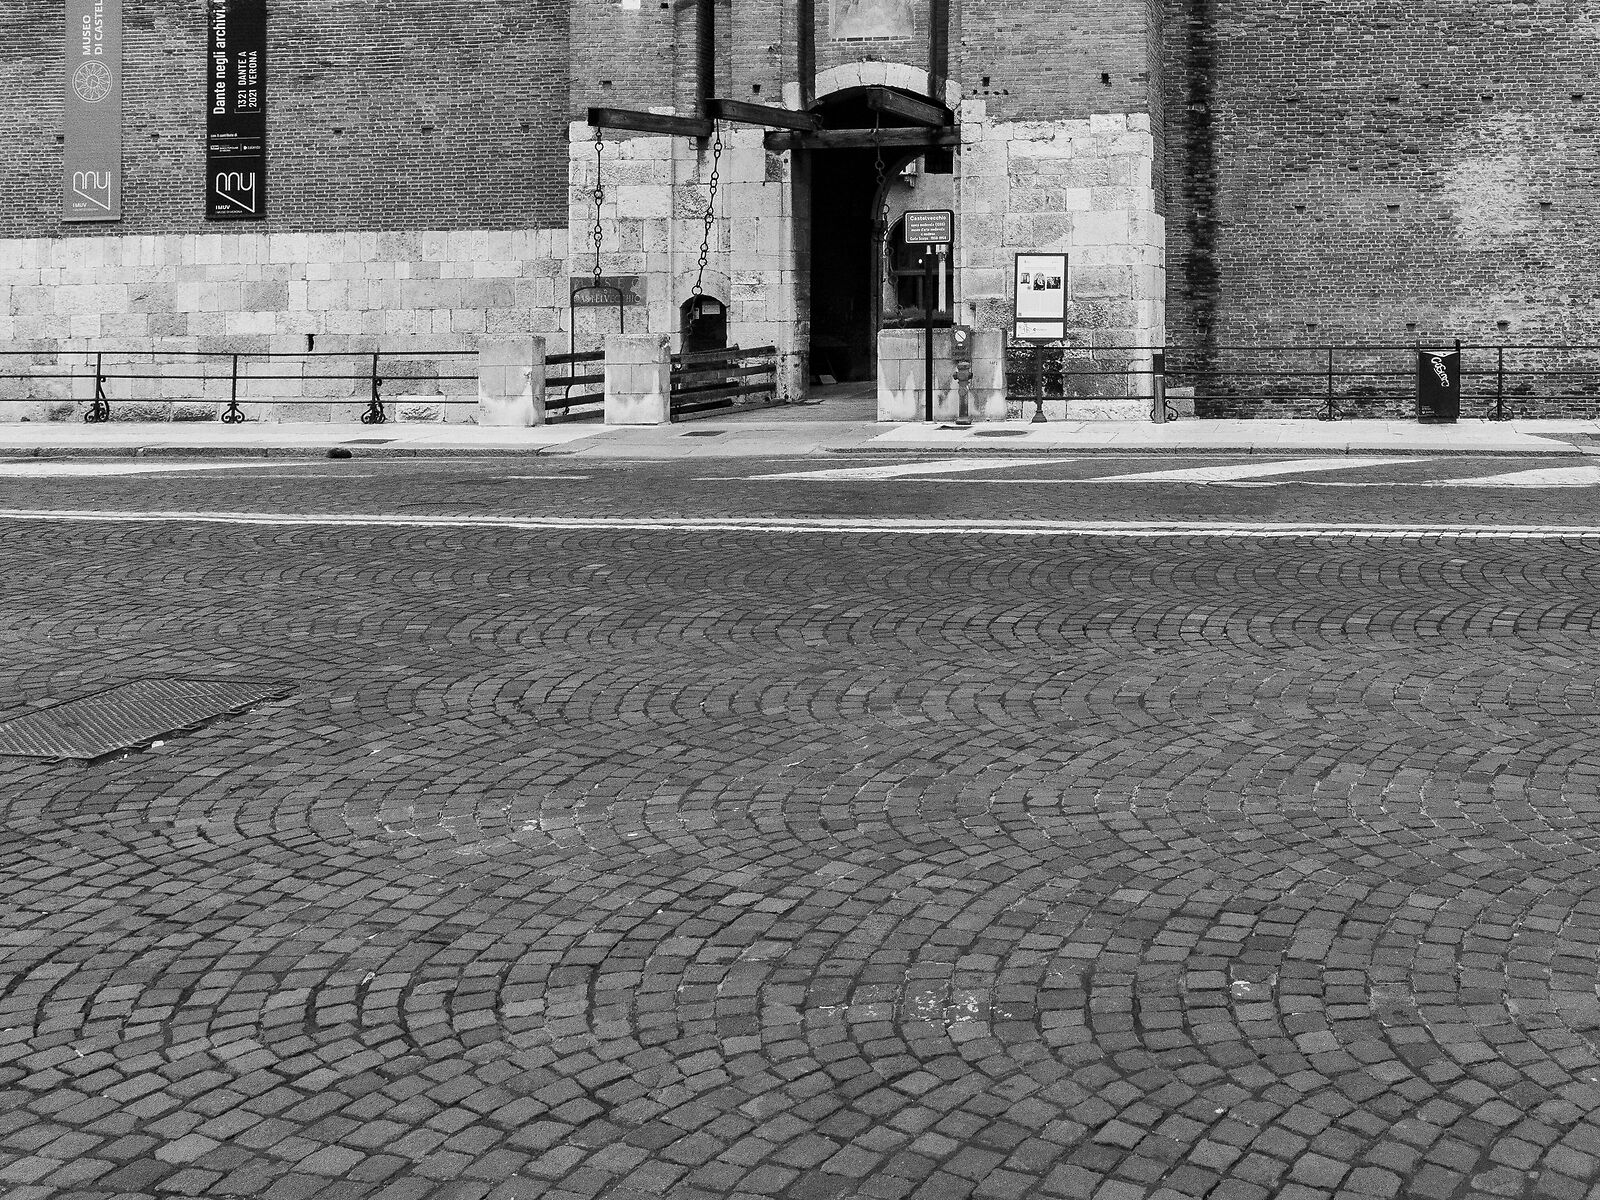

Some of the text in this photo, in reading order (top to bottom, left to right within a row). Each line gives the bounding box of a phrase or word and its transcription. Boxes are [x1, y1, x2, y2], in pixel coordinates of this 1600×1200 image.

[82, 15, 91, 55] MUSEO
[213, 6, 226, 49] archivi.
[94, 43, 103, 55] DI
[213, 51, 229, 79] negli
[237, 59, 247, 86] DANTE
[248, 50, 257, 108] 2021 VERONA
[213, 81, 226, 114] Dante
[237, 90, 247, 108] 1321
